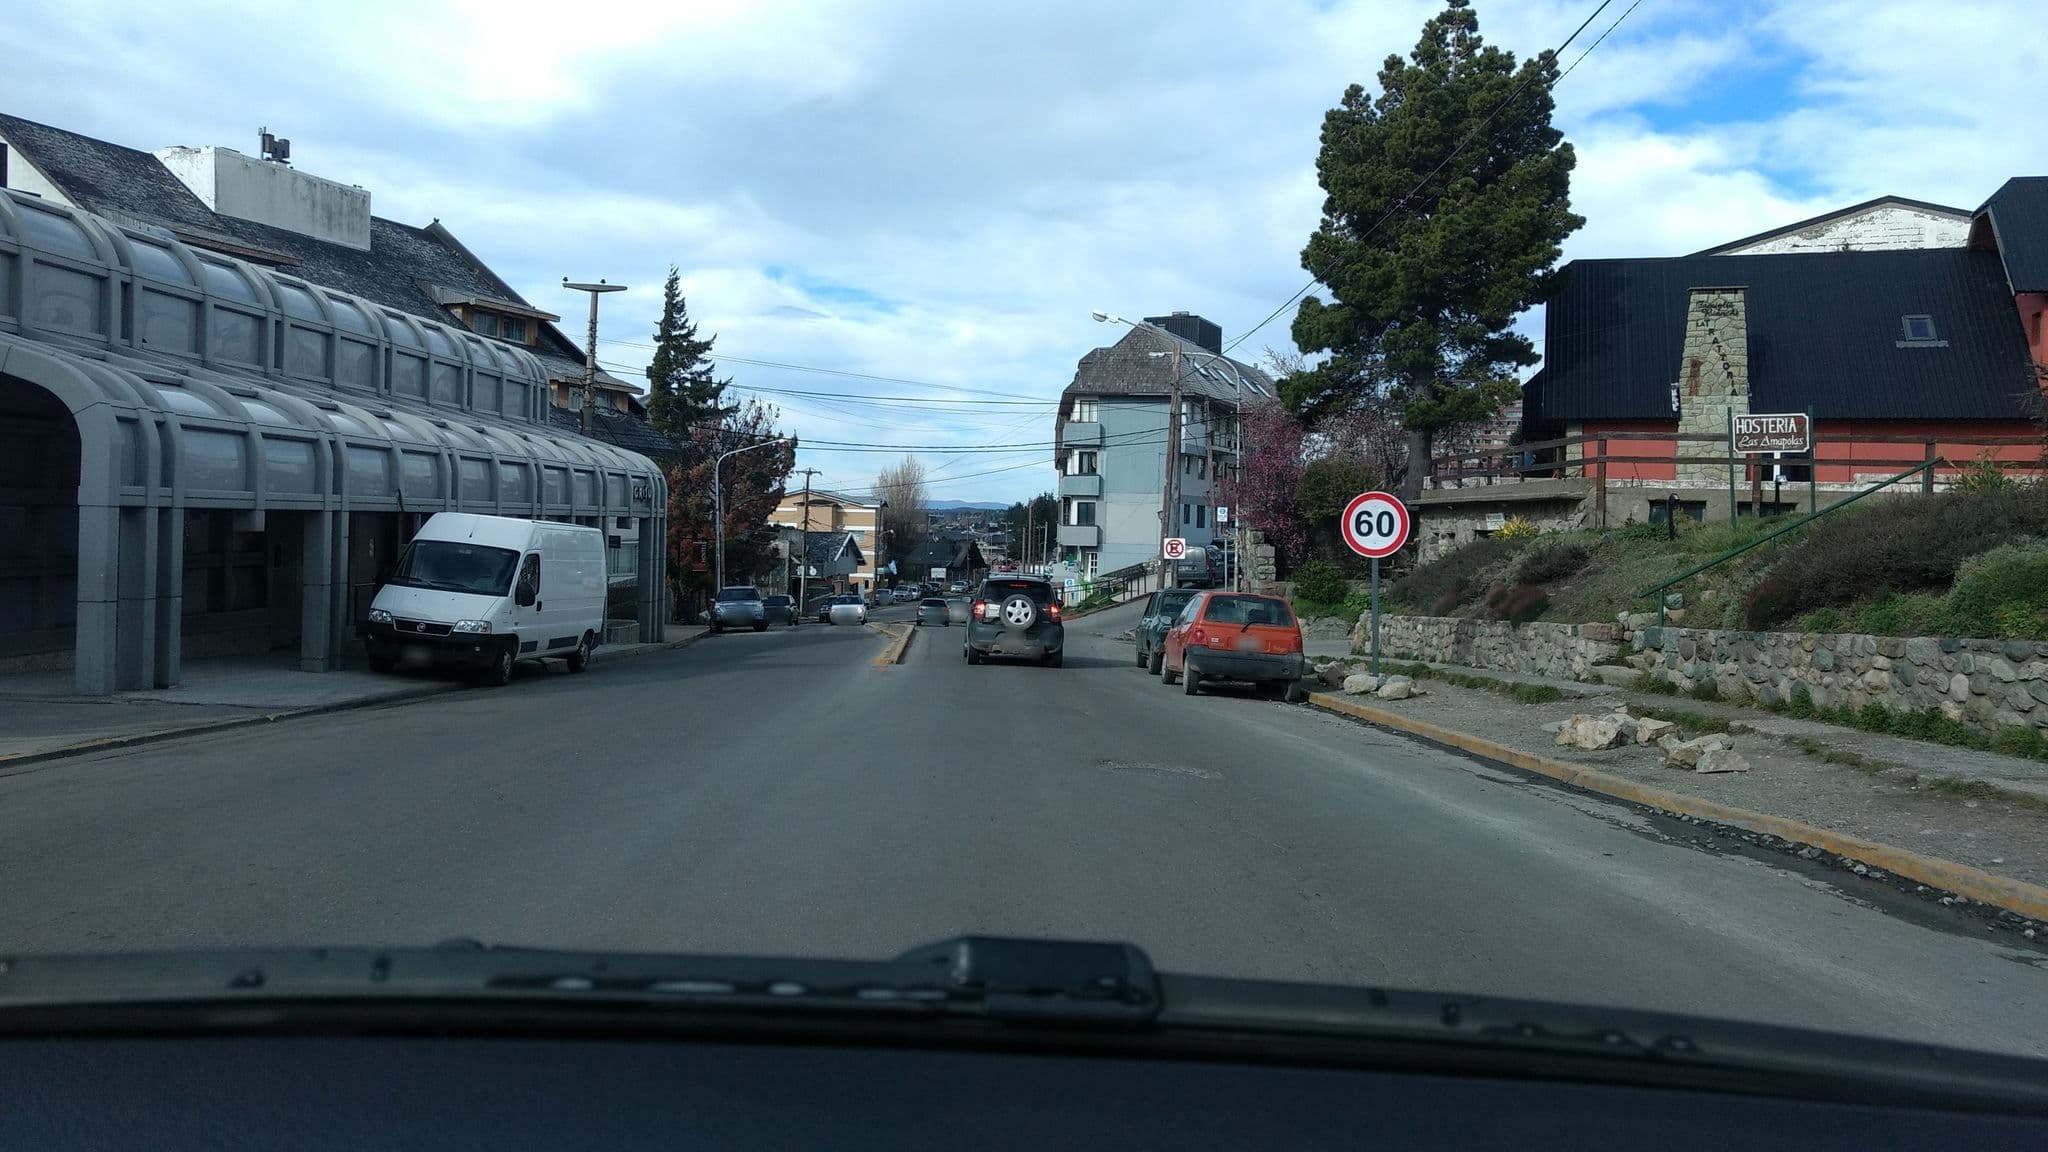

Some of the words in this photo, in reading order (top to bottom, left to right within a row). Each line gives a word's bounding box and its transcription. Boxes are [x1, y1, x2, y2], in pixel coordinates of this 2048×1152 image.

[1704, 320, 1738, 396] TRATTORIA
[1736, 417, 1797, 434] HOSTERIA
[1738, 435, 1758, 448] Las
[1760, 434, 1804, 450] Amapolas
[1355, 510, 1395, 537] 60
